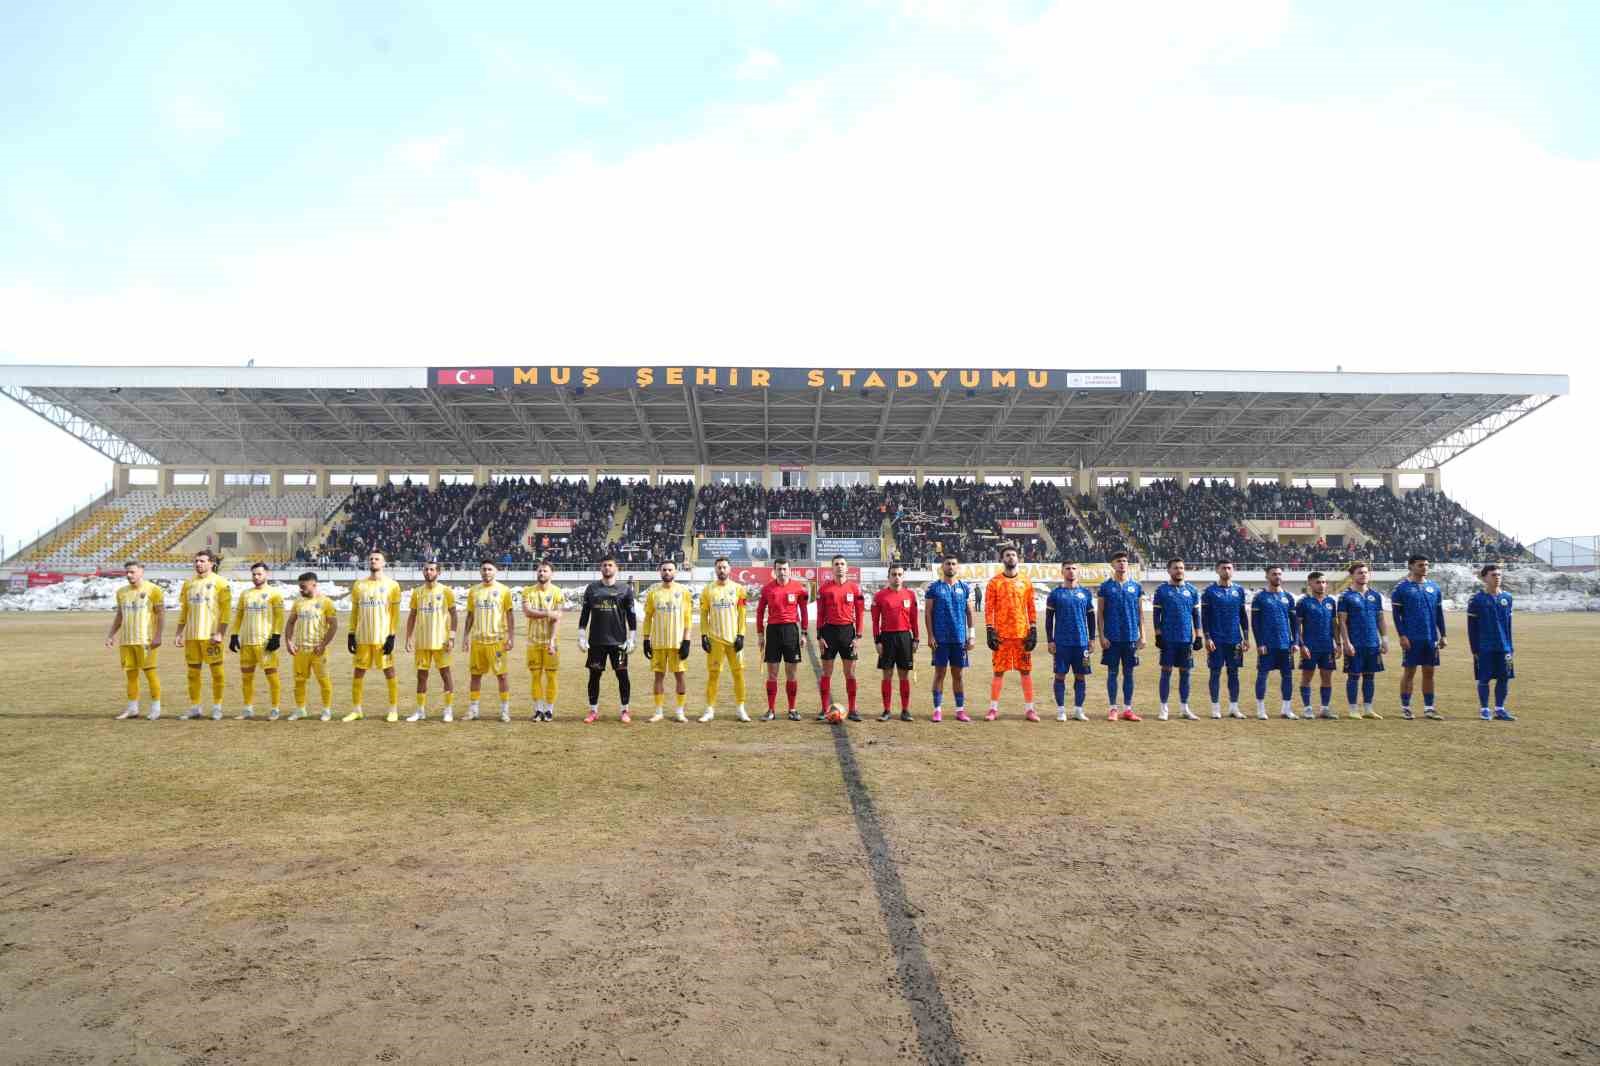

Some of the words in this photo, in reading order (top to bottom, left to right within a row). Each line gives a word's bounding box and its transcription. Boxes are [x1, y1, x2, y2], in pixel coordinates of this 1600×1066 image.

[513, 367, 600, 388] MUŞ
[636, 367, 771, 388] ŞEHİR
[807, 368, 1048, 388] STADYUMU
